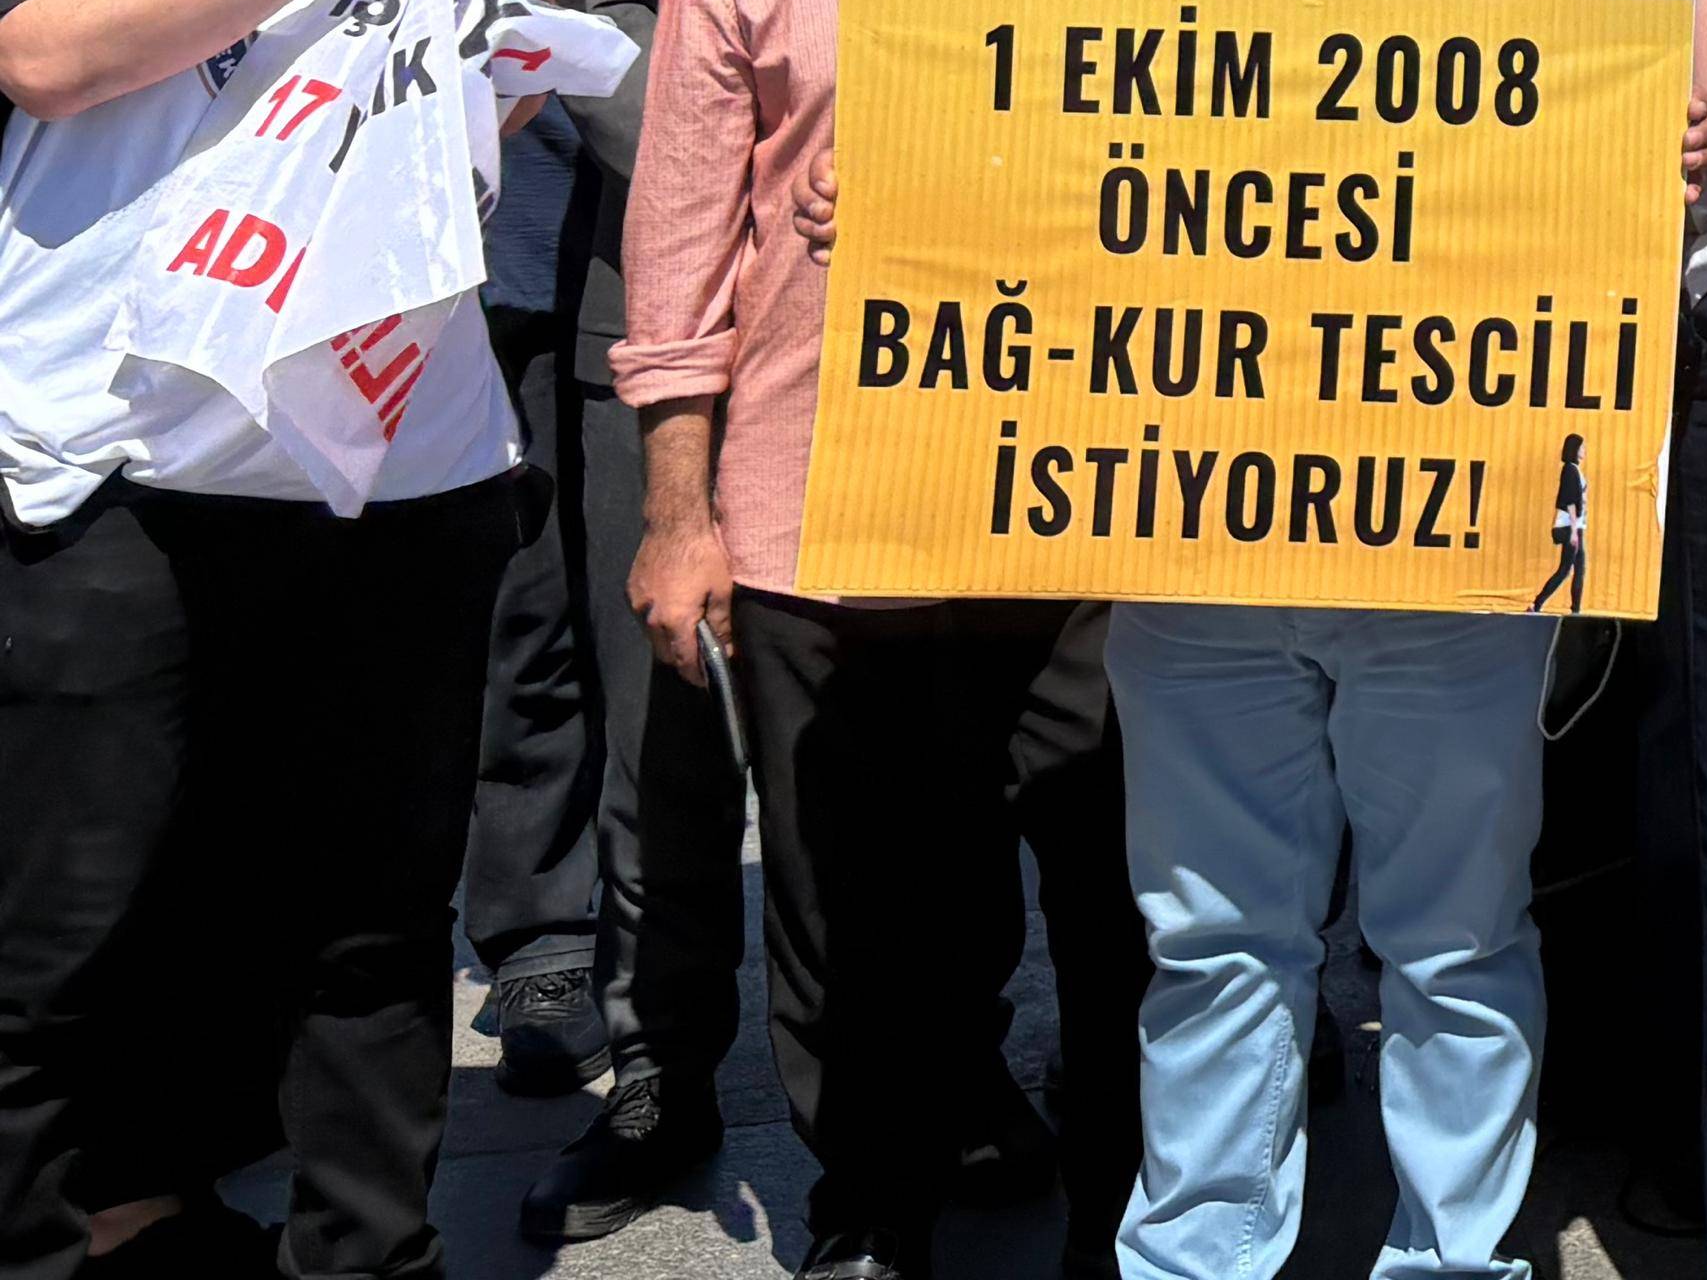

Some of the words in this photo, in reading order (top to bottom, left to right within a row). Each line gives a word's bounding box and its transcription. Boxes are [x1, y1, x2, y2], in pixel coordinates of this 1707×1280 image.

[256, 74, 342, 141] 17
[984, 23, 1015, 112] 1
[1062, 4, 1273, 119] EKİM
[1315, 33, 1542, 128] 2008
[1097, 142, 1416, 264] ÖNCESİ
[857, 278, 1269, 401] BAĞ-KUR
[1310, 294, 1639, 412] TESCİLİ
[989, 420, 1490, 550] İSTİYORUZ!
